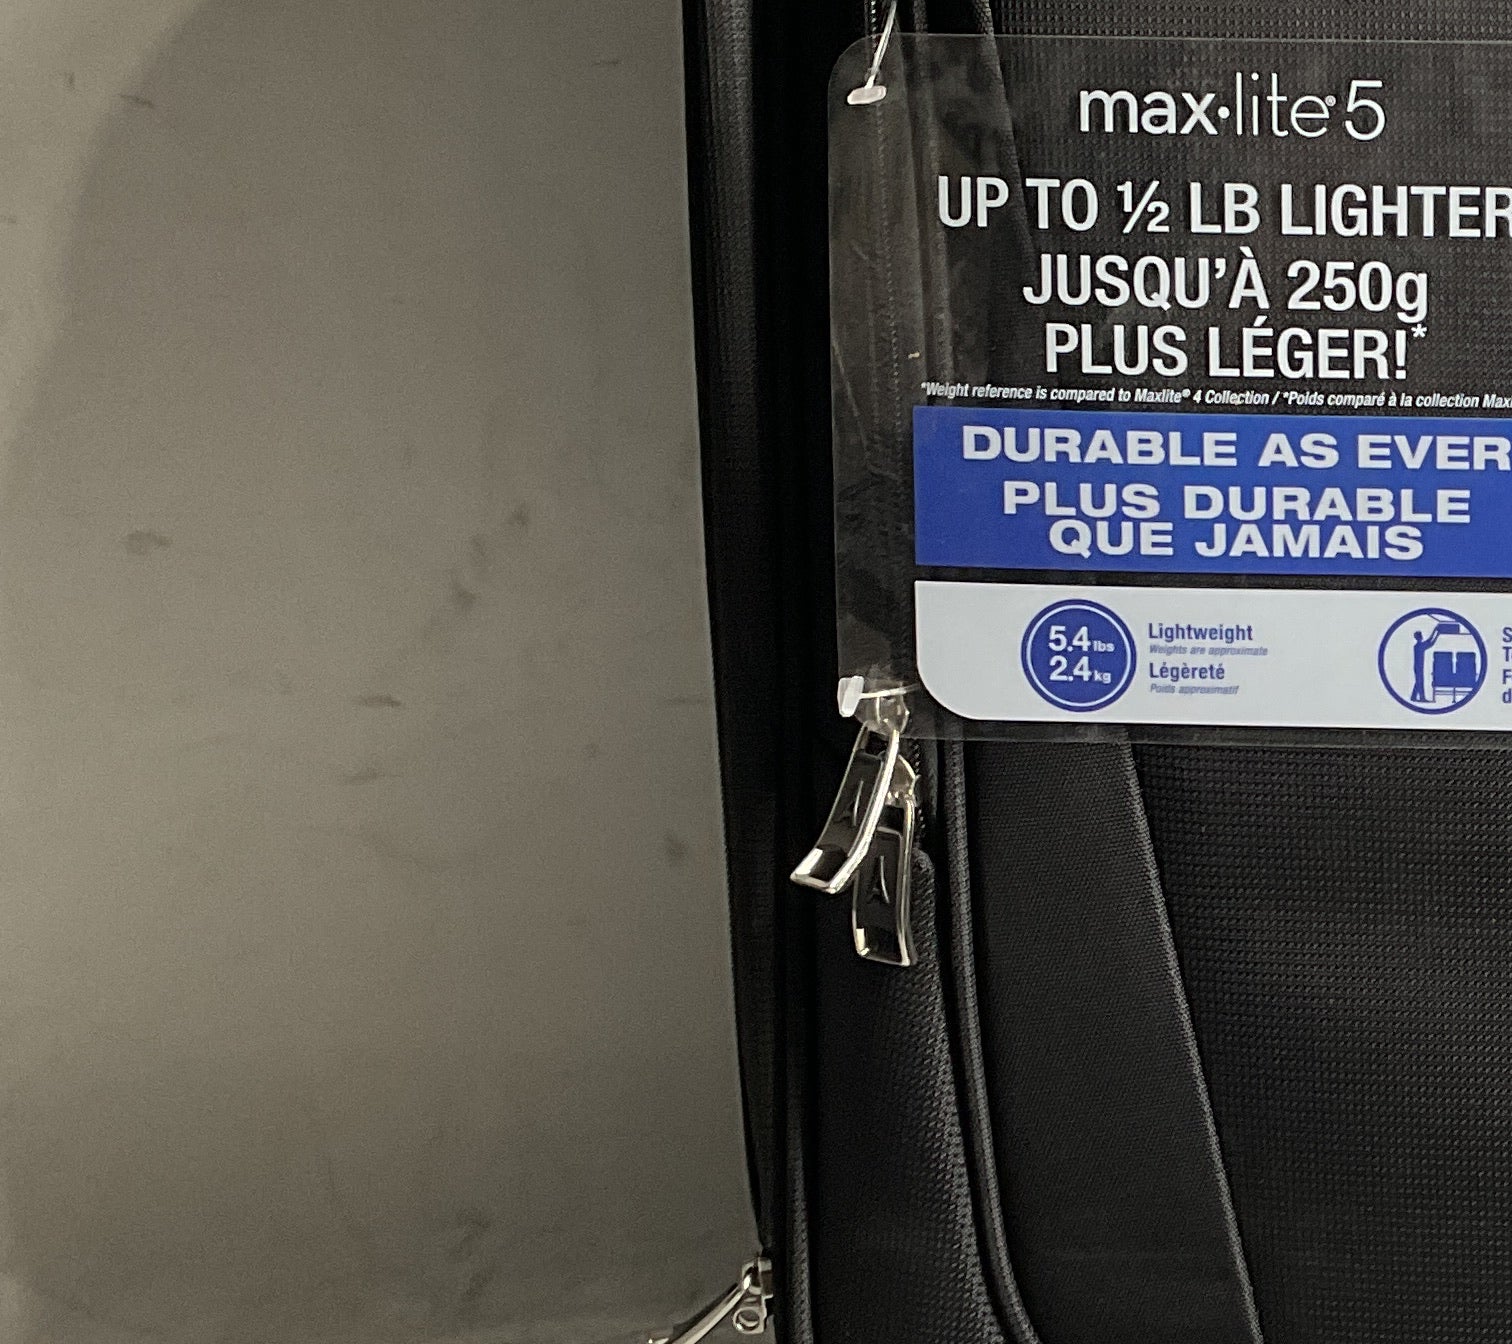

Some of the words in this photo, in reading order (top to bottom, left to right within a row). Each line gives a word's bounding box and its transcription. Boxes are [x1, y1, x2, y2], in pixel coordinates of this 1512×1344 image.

[1344, 79, 1386, 142] 5
[938, 175, 1009, 228] UP
[1025, 178, 1096, 231] TO
[1191, 182, 1260, 235] LB
[1288, 260, 1429, 325] 250g
[1045, 323, 1188, 377] PLUS
[971, 385, 1032, 399] reference
[1035, 386, 1047, 399] is
[1050, 387, 1114, 405] compared
[1118, 389, 1131, 401] to
[1193, 391, 1202, 403] 4
[1205, 391, 1270, 406] Collection
[1327, 392, 1385, 410] comparé
[1388, 392, 1397, 406] à
[1400, 395, 1412, 406] la
[1415, 394, 1480, 408] collection
[962, 425, 1237, 467] DURABLE
[1258, 432, 1340, 468] AS
[1358, 435, 1511, 471] EVER
[1003, 481, 1160, 519] PLUS
[1184, 485, 1471, 524] DURABLE
[1049, 520, 1174, 559] QUE
[1195, 523, 1424, 560] JAMAIS
[1149, 623, 1253, 644] Lightweight
[1149, 662, 1225, 683] Légèreté
